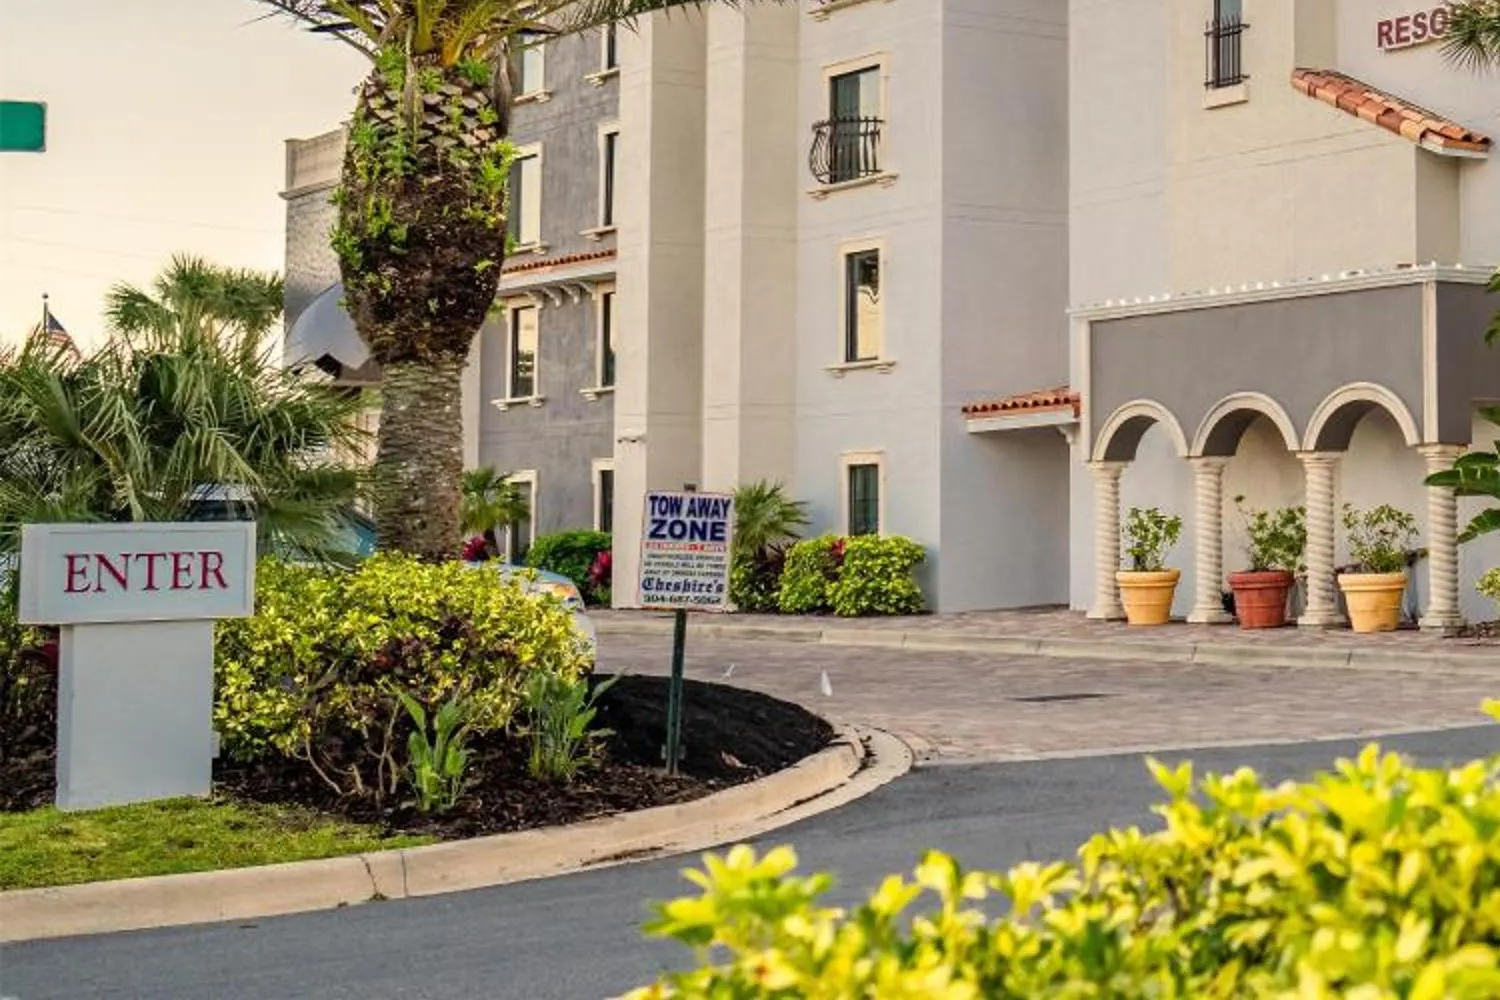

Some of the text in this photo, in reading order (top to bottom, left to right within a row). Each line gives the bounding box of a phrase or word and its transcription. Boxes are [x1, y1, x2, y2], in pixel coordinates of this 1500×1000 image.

[1377, 3, 1456, 48] RESO
[649, 495, 730, 519] TOW AWAY
[649, 519, 726, 542] ZONE
[63, 551, 229, 593] ENTER
[642, 577, 724, 593] Cheshire's
